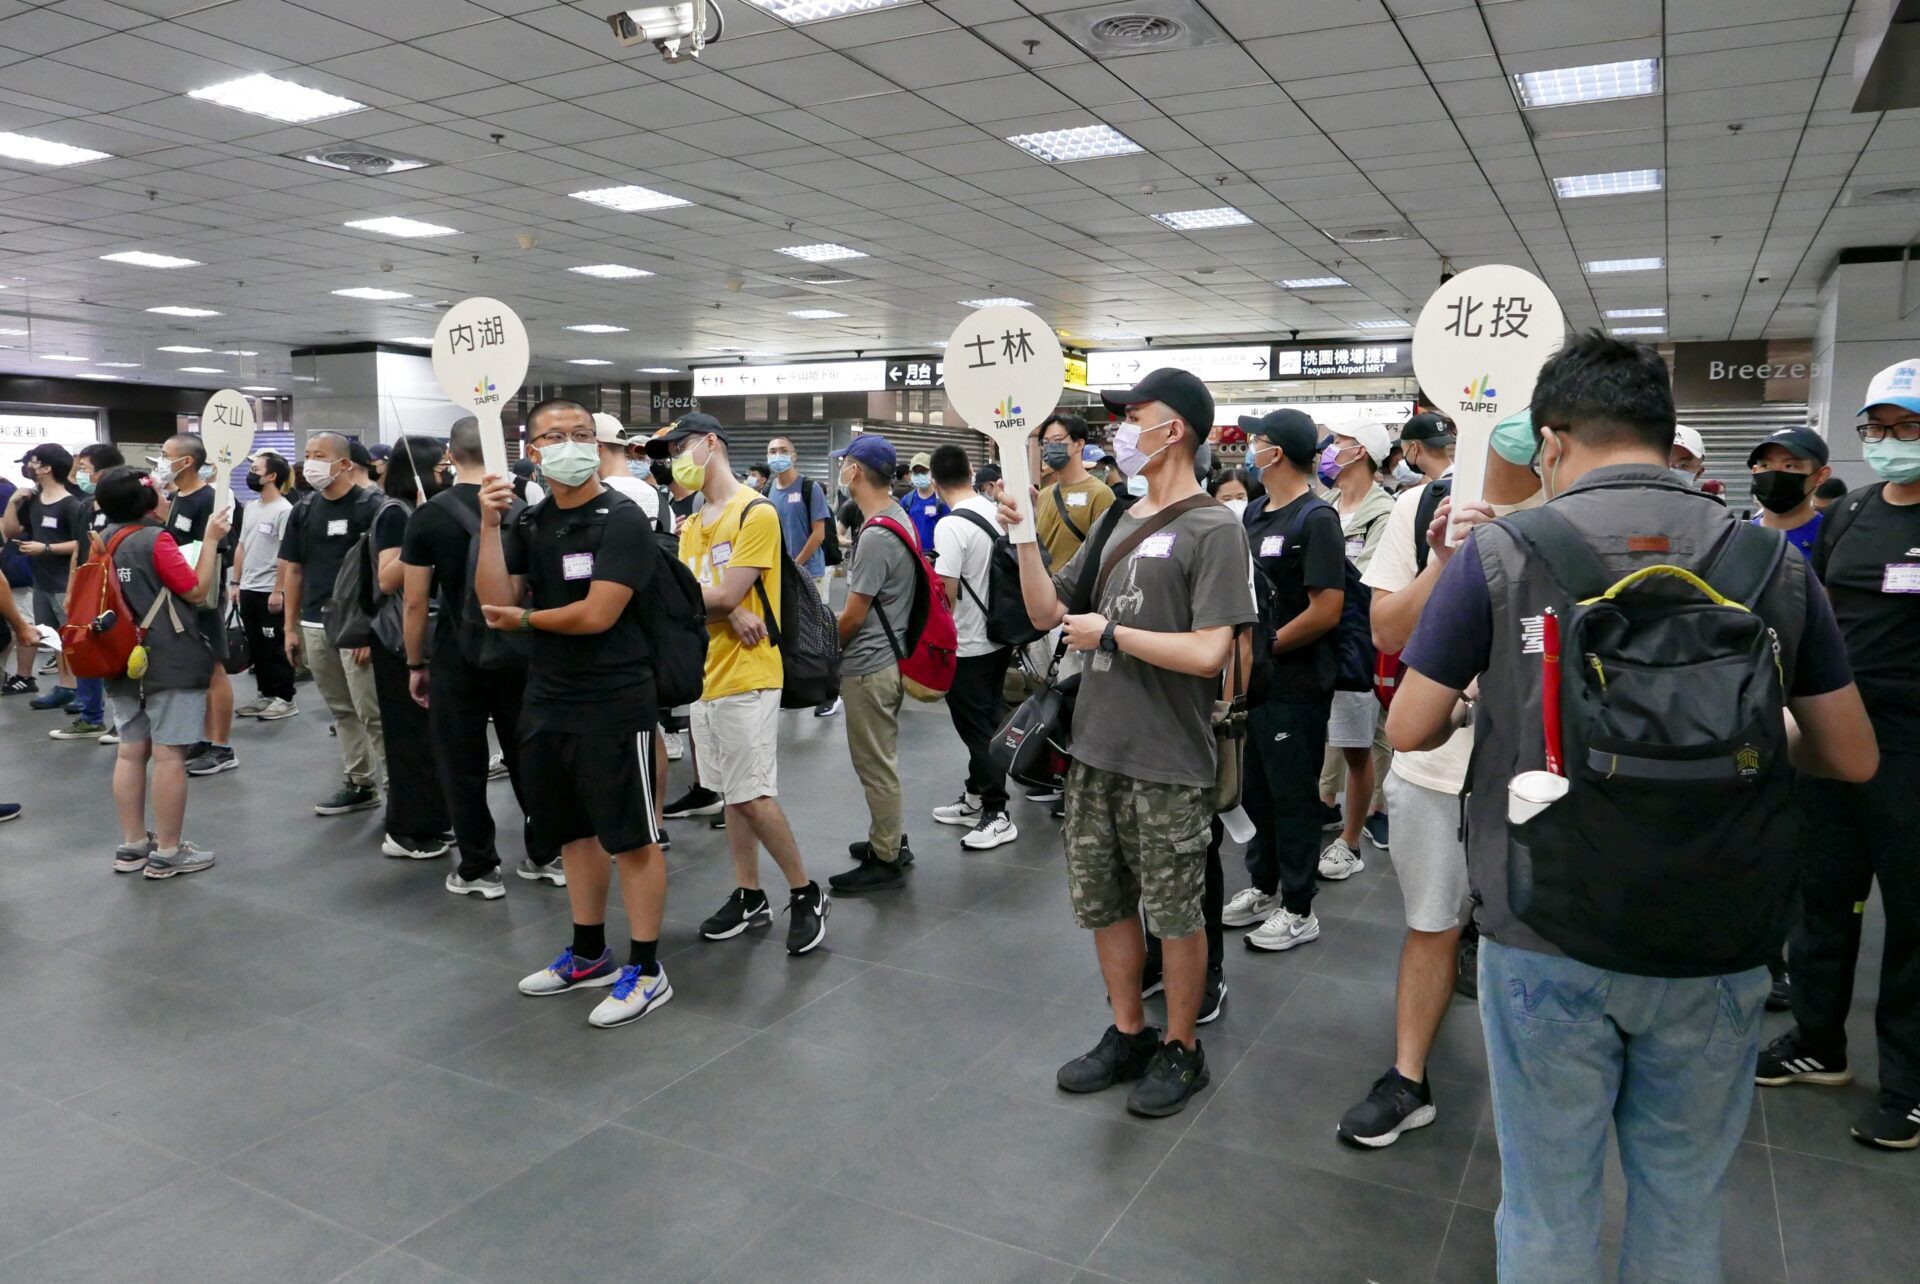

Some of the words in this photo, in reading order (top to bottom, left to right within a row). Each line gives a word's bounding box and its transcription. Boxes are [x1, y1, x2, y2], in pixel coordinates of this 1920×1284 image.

[1444, 295, 1533, 339] 北投
[964, 327, 1035, 369] 士林
[1303, 347, 1398, 366] 桃園機場捷運
[906, 362, 932, 379] 月台
[1302, 365, 1336, 376] Taoyuan
[1336, 364, 1365, 375] Airport
[1366, 363, 1386, 373] MRT
[1709, 360, 1806, 380] Breeze
[474, 393, 500, 405] TAIPEI
[653, 394, 698, 409] Breeze
[1459, 401, 1498, 413] TAIPEI
[213, 403, 244, 427] 文山
[993, 417, 1026, 429] TAIPEI
